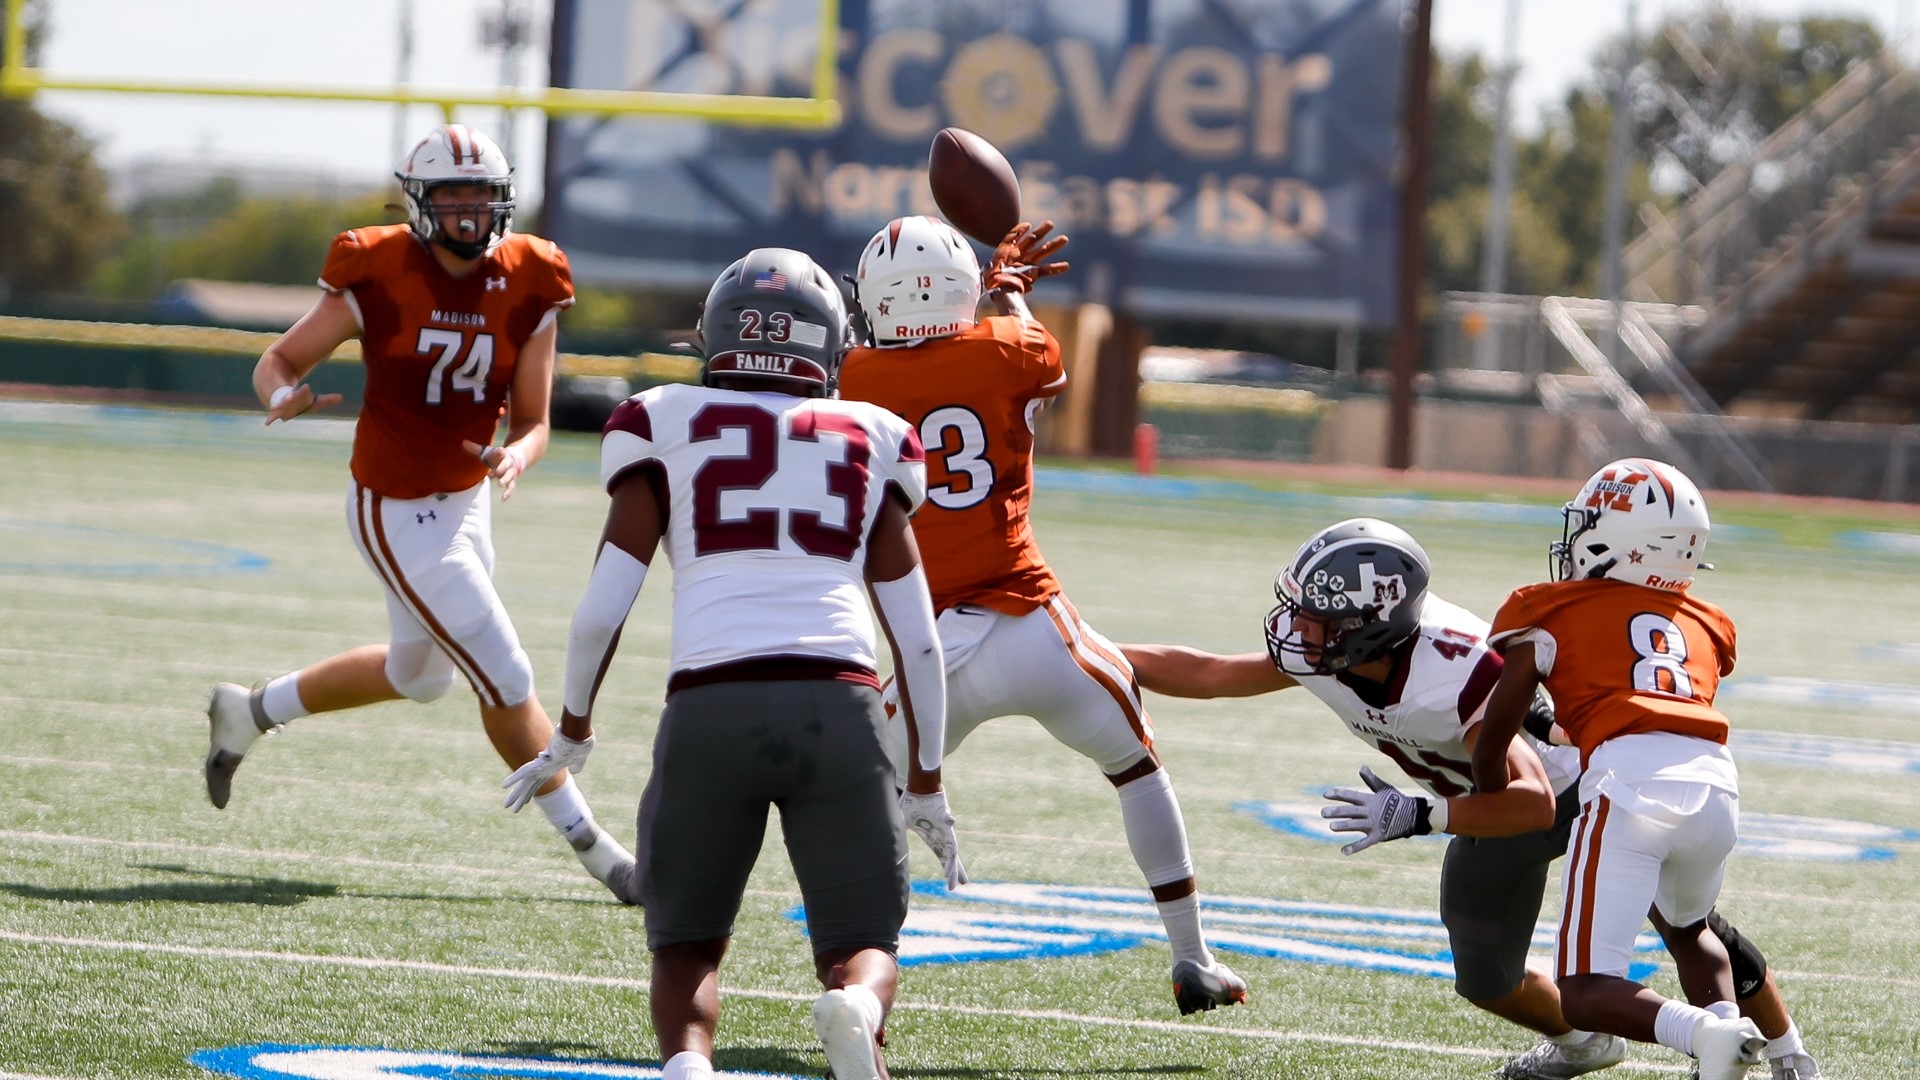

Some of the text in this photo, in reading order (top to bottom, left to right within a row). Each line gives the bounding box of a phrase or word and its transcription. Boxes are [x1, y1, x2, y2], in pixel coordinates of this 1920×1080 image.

[1017, 160, 1180, 238] East
[1195, 172, 1328, 243] ISD
[916, 275, 931, 289] 13
[431, 309, 486, 326] MADISON
[739, 309, 794, 344] 23
[895, 322, 959, 338] Riddell
[415, 327, 495, 404] 74
[735, 353, 794, 374] FAMILY
[920, 404, 997, 511] 3
[688, 401, 871, 563] 23
[1689, 534, 1697, 547] 8
[1645, 574, 1692, 593] Ridd
[1431, 627, 1481, 662] 41
[1627, 612, 1695, 700] 8
[1351, 720, 1423, 748] MARSHALL
